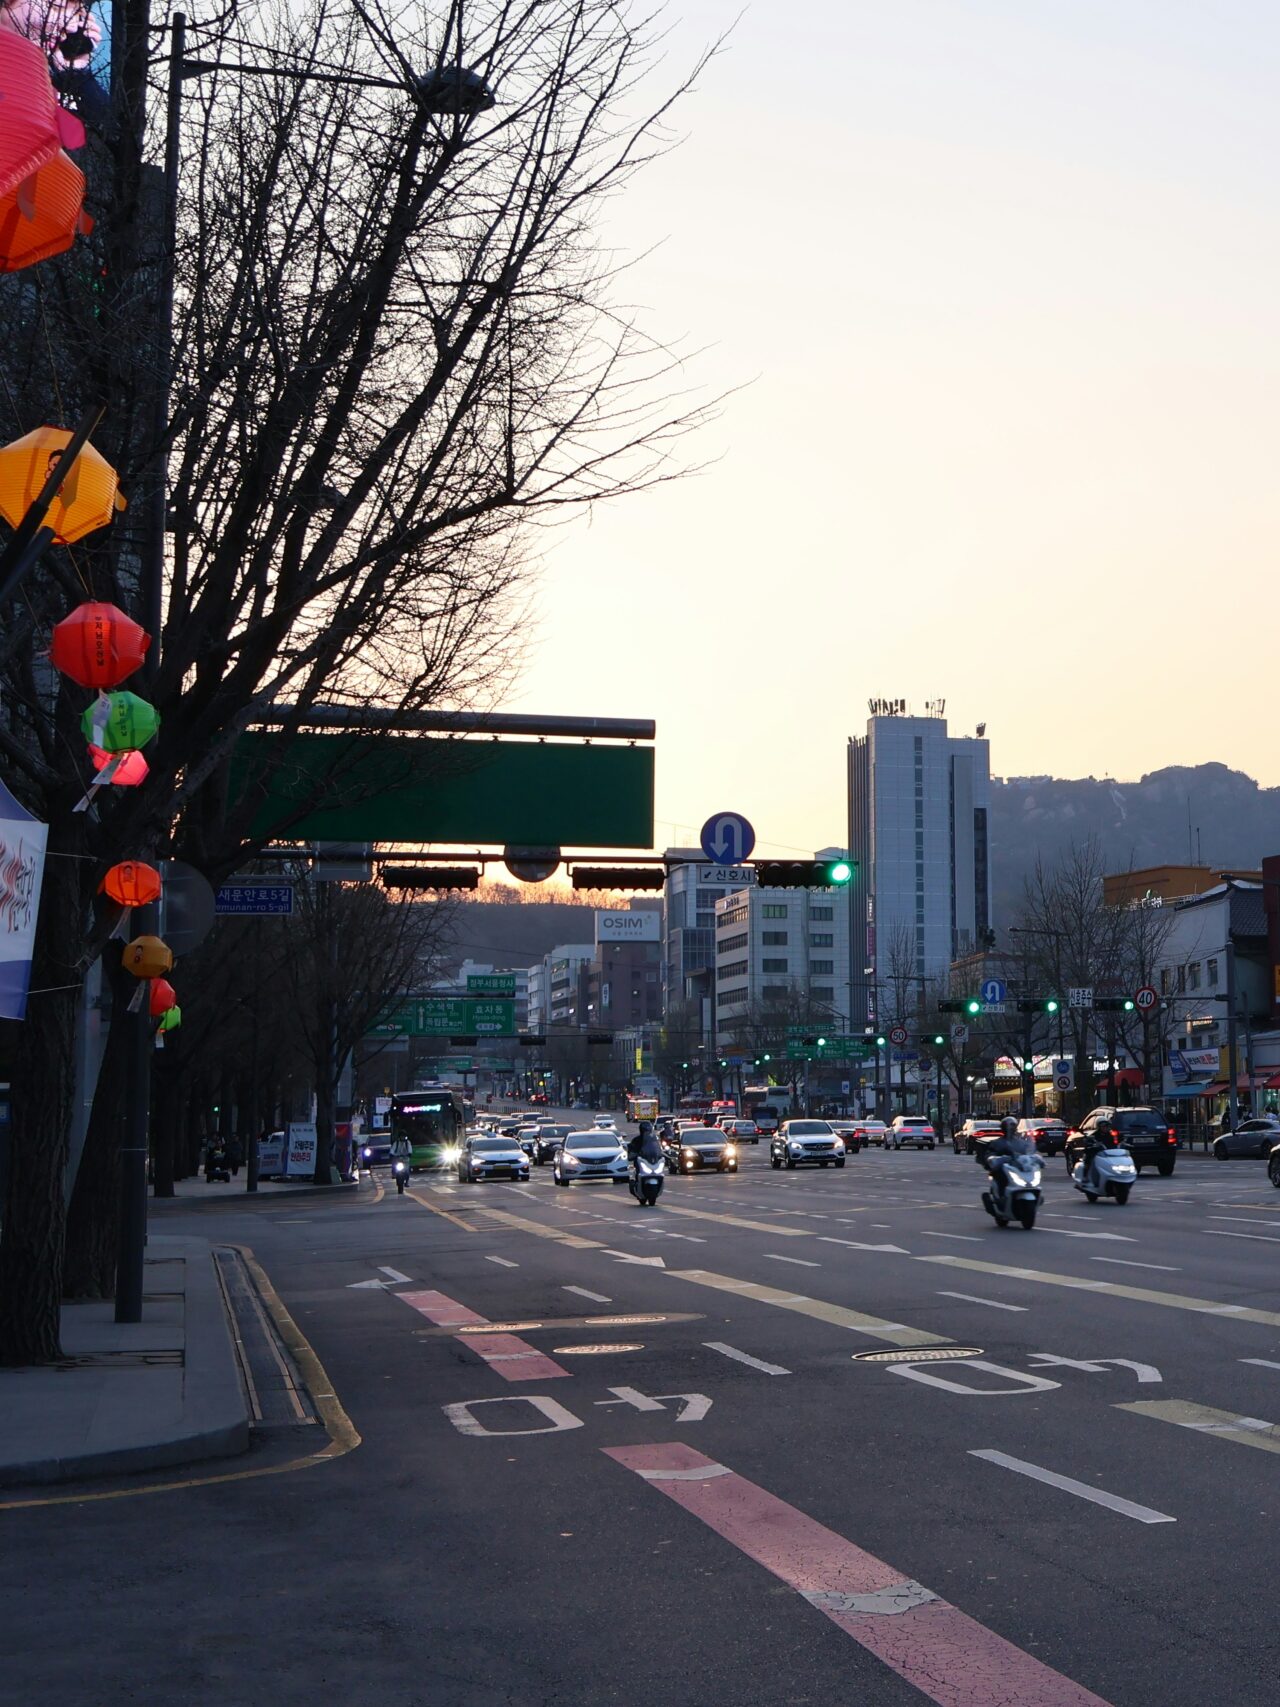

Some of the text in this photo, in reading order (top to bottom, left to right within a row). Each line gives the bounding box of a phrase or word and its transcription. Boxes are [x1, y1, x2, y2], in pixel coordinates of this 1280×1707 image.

[716, 869, 751, 881] 신호시
[217, 889, 289, 902] 새문안로5길
[603, 917, 643, 929] OSIM
[1070, 988, 1092, 1007] 신호준수
[1138, 992, 1153, 1005] 40
[474, 1004, 503, 1015] 효자동
[893, 1031, 904, 1041] 50
